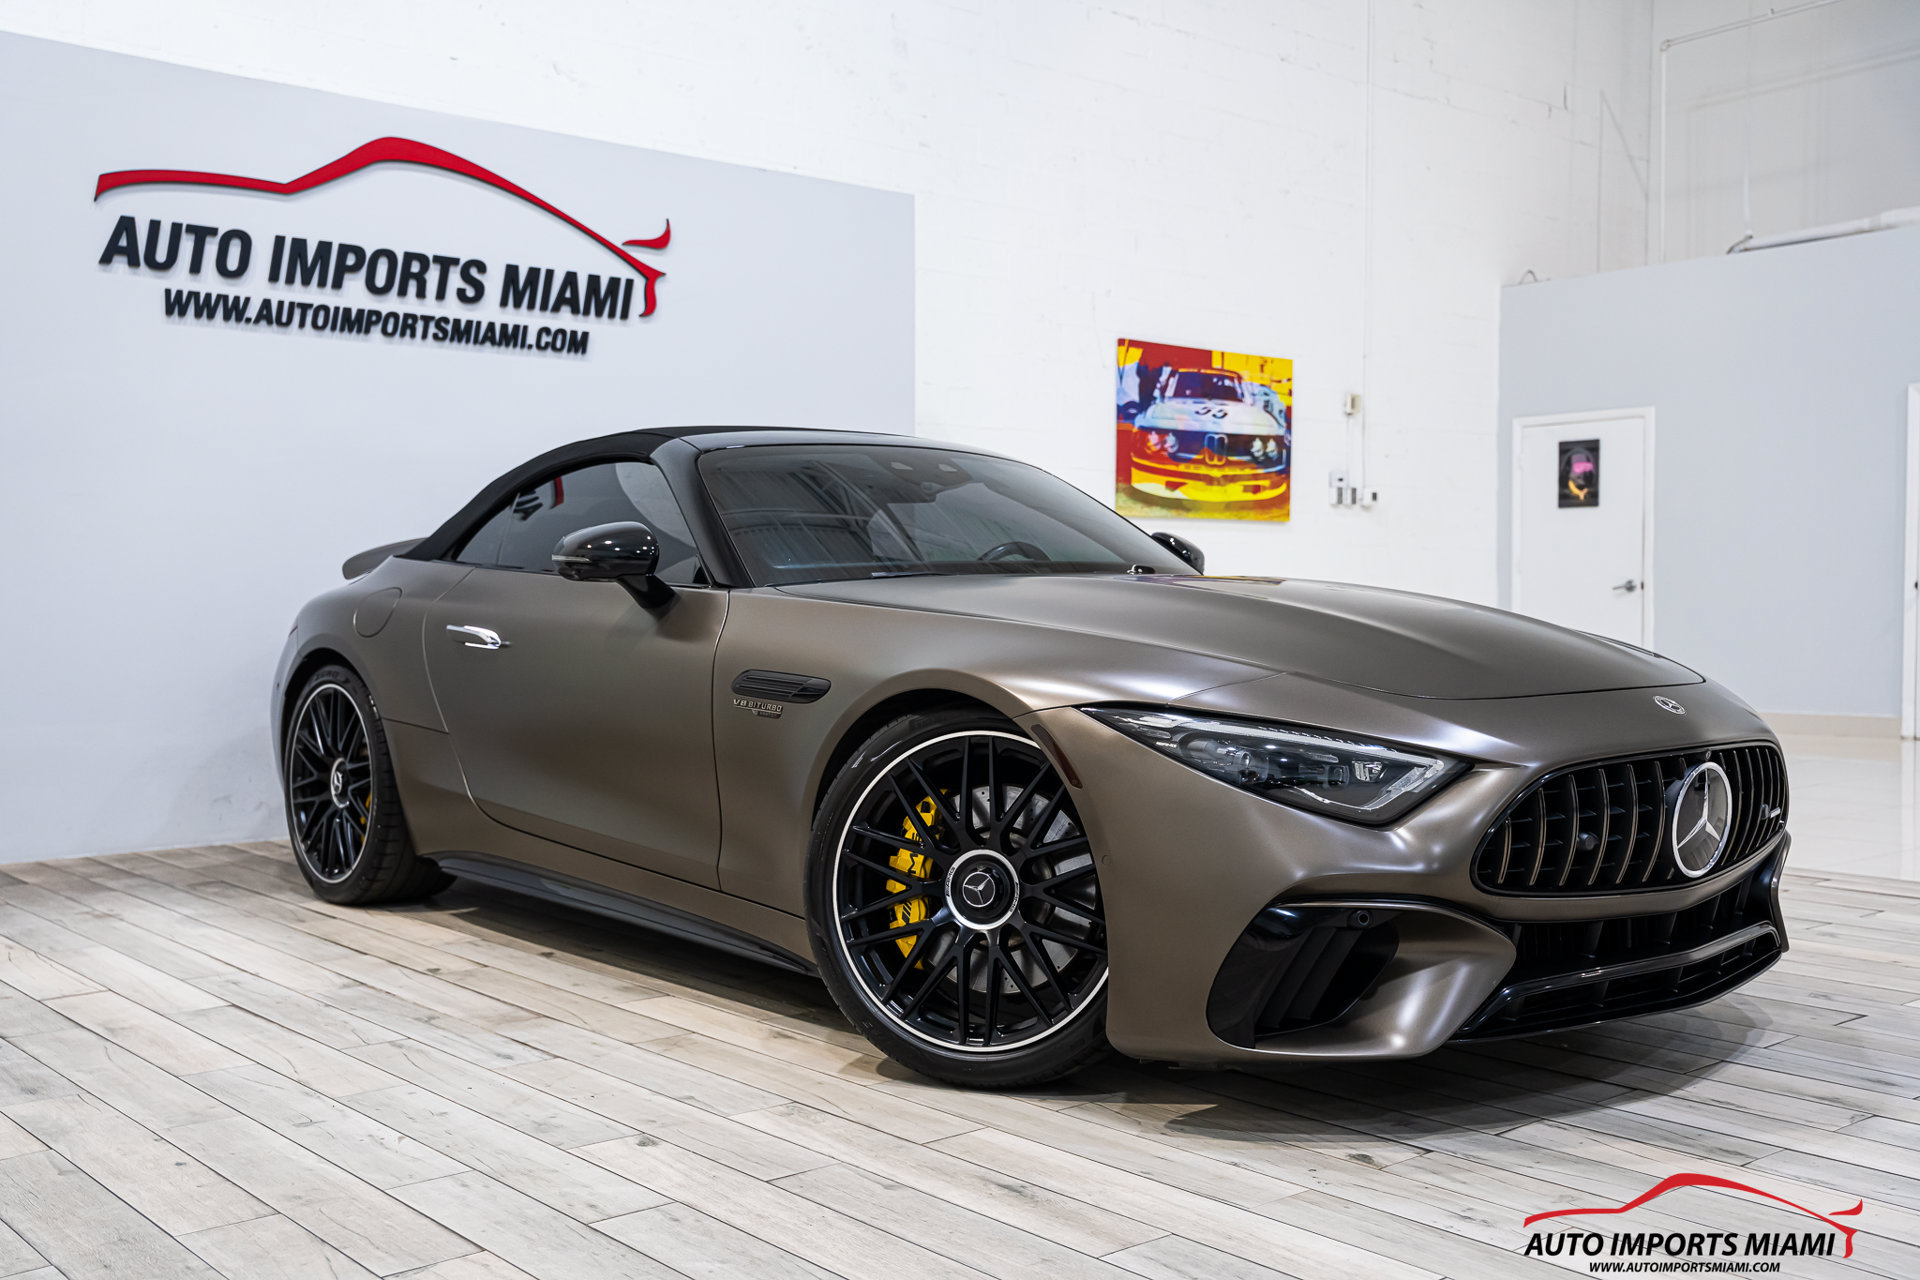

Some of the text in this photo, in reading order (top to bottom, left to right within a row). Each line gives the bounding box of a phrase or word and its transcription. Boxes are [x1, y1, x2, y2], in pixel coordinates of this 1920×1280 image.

[98, 214, 635, 321] AUTO IMPORTS MIAMI
[163, 287, 590, 355] WWW.AUTOIMPORTSMIAMI.COM
[748, 702, 783, 712] BITURBO
